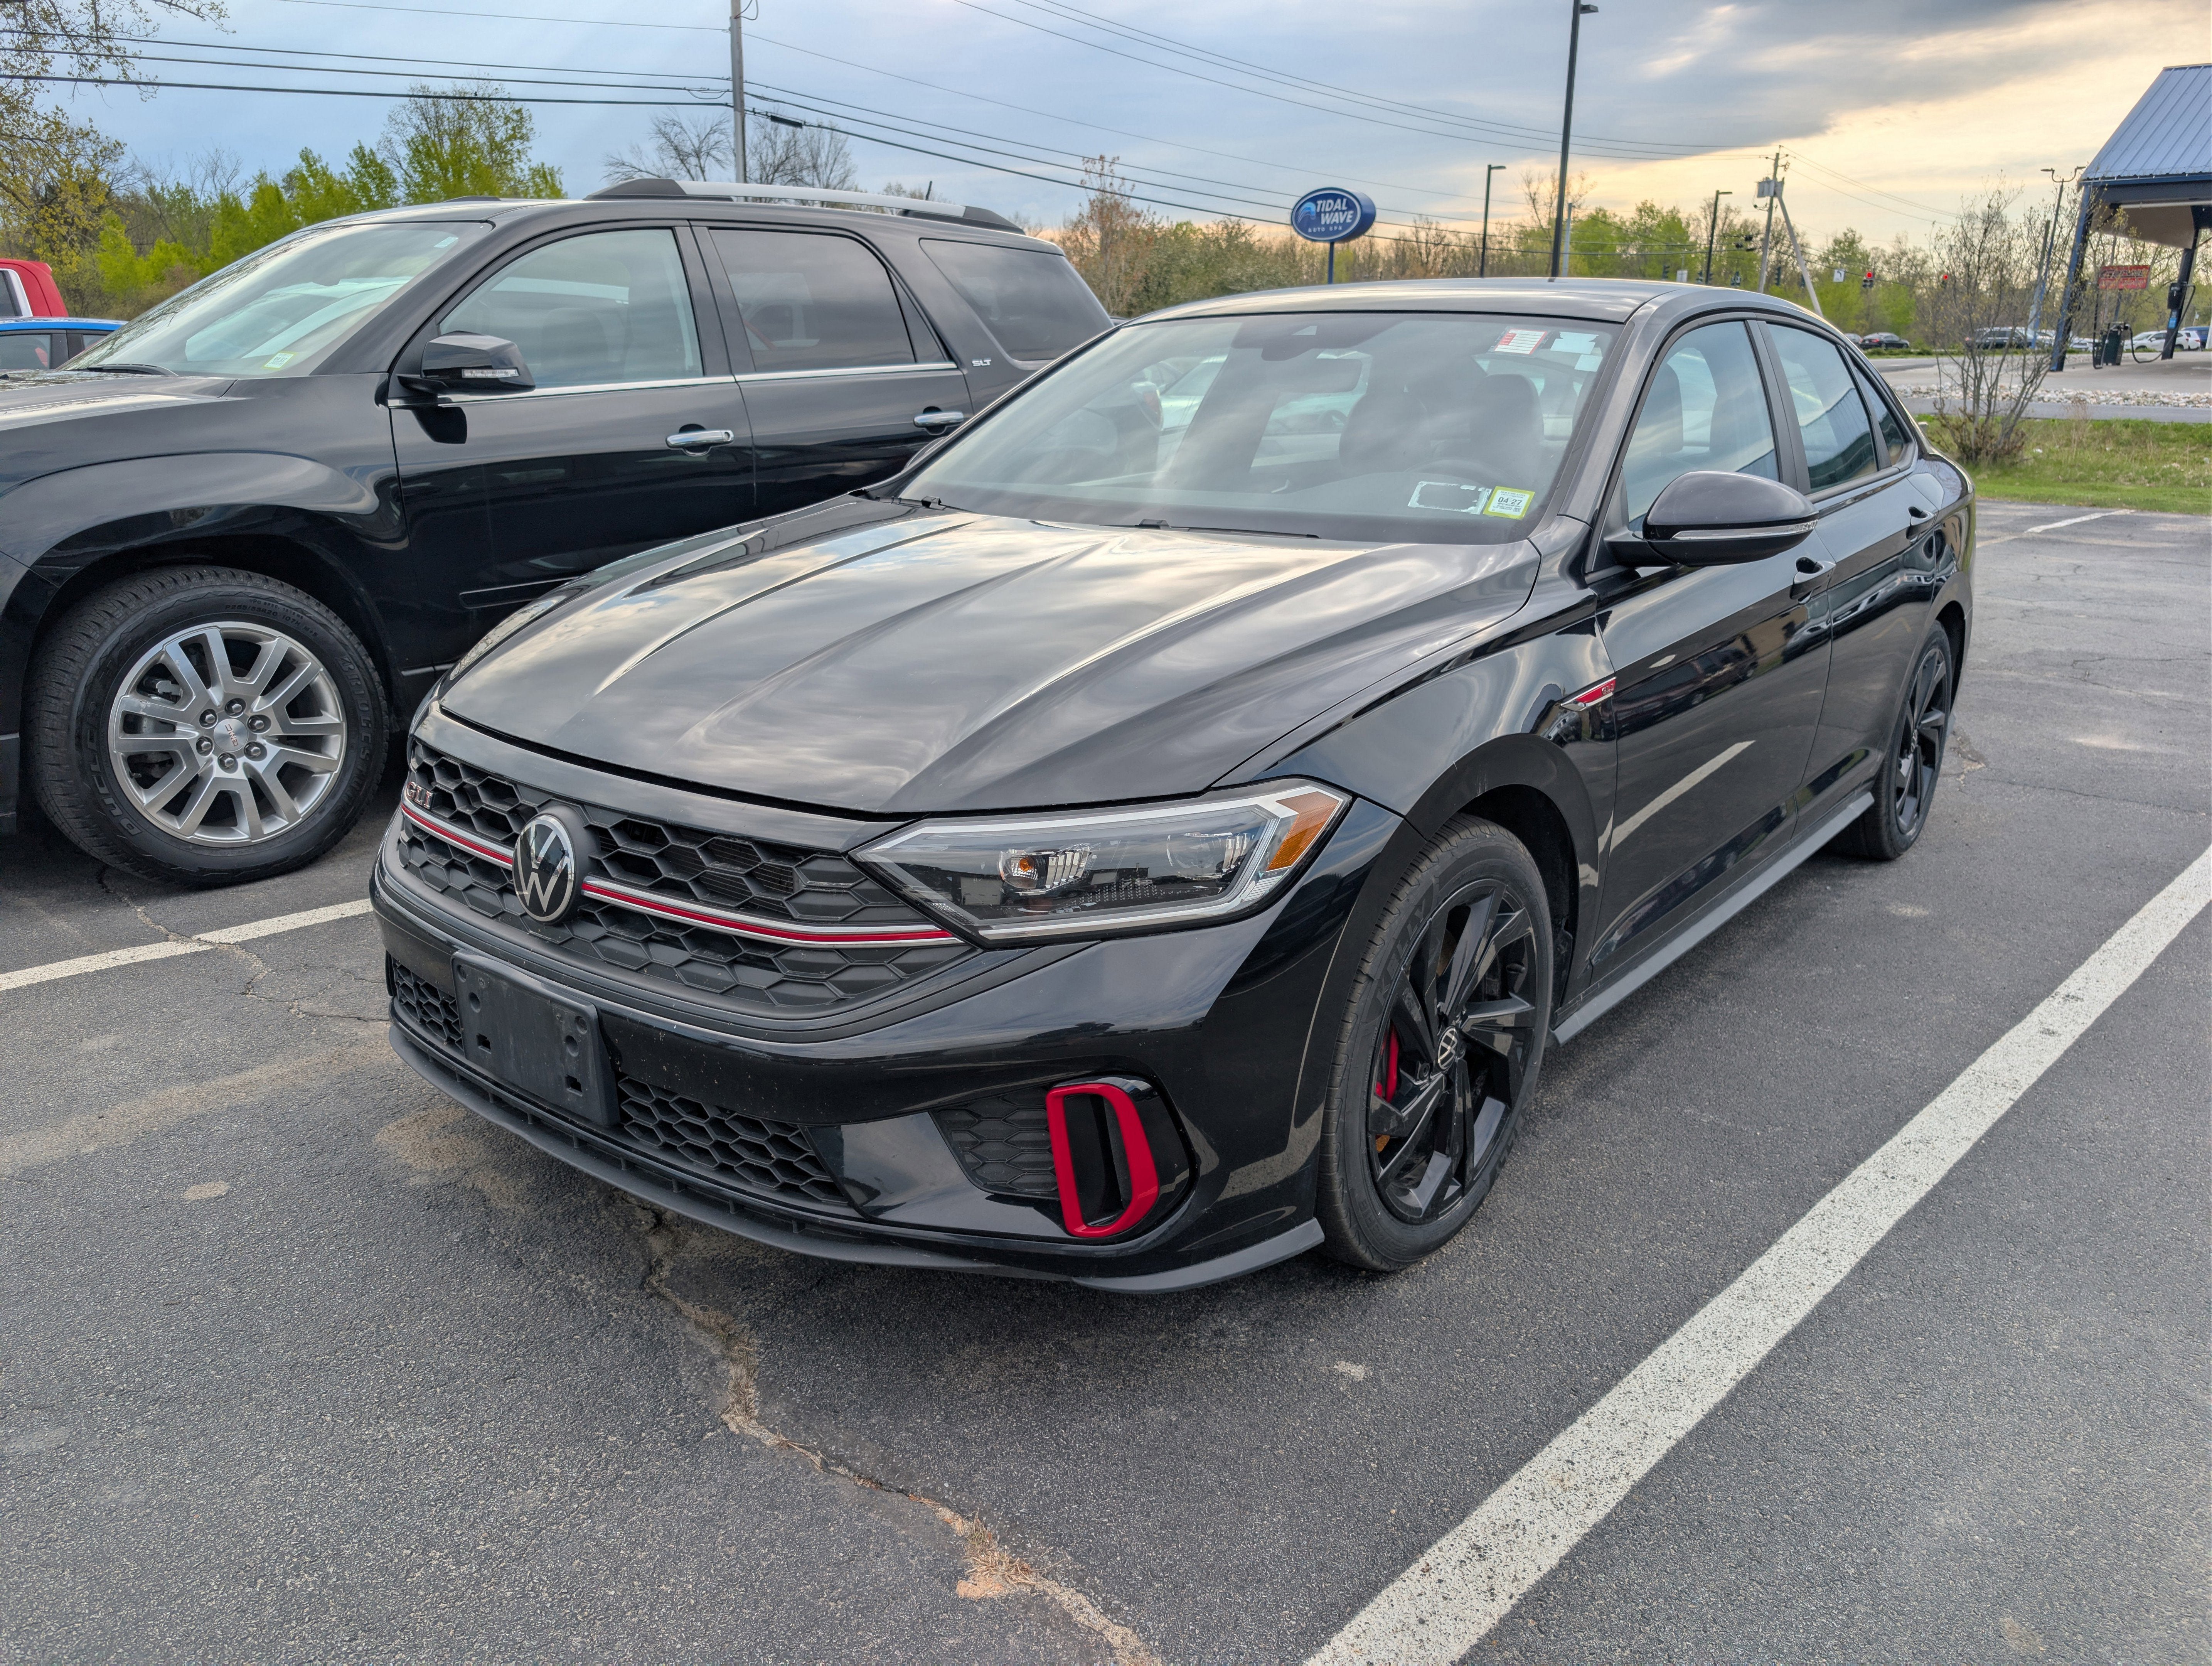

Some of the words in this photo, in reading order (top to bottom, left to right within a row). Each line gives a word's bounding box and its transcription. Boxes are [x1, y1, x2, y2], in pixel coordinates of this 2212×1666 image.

[1316, 197, 1348, 212] TIDAL
[1321, 210, 1354, 225] WAVE
[972, 358, 991, 367] SLT
[224, 723, 239, 746] GMC
[331, 654, 373, 820] BRIDGESTONE
[85, 701, 142, 837] DUELER
[405, 781, 435, 810] GLI
[514, 816, 574, 920] VW
[1376, 898, 1426, 1007] KELLY
